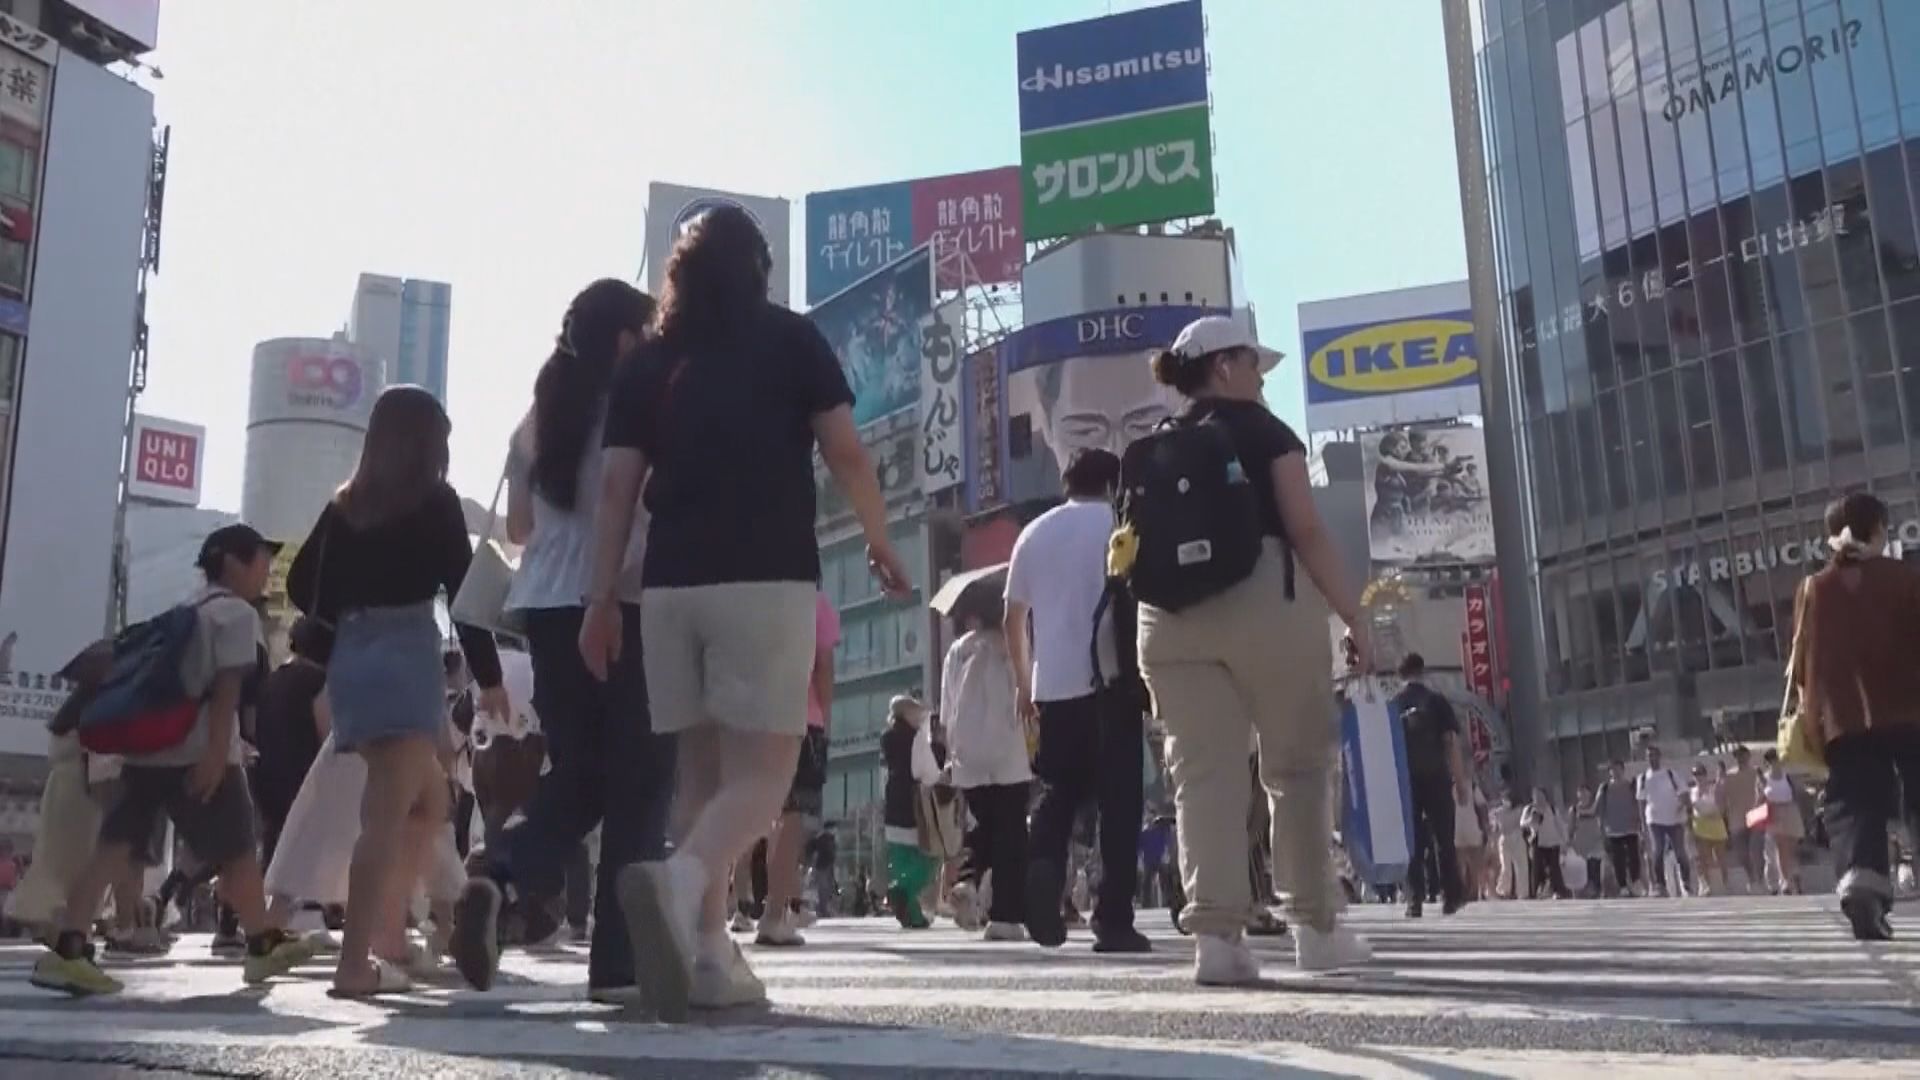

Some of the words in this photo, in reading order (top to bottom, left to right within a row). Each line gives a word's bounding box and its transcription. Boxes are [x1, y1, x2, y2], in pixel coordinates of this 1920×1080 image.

[1021, 47, 1202, 92] Hisamitsu
[1663, 19, 1862, 122] OMAMORI?
[1032, 139, 1200, 204] サロンパス
[827, 206, 891, 241] 龍角散
[937, 193, 1004, 227] 龍角散
[1078, 312, 1145, 344] DHC
[1326, 334, 1477, 378] IKEA
[922, 305, 961, 480] もんじゃ
[146, 434, 187, 460] UNI
[144, 457, 189, 482] QLO
[1652, 534, 1830, 591] STARBUCK
